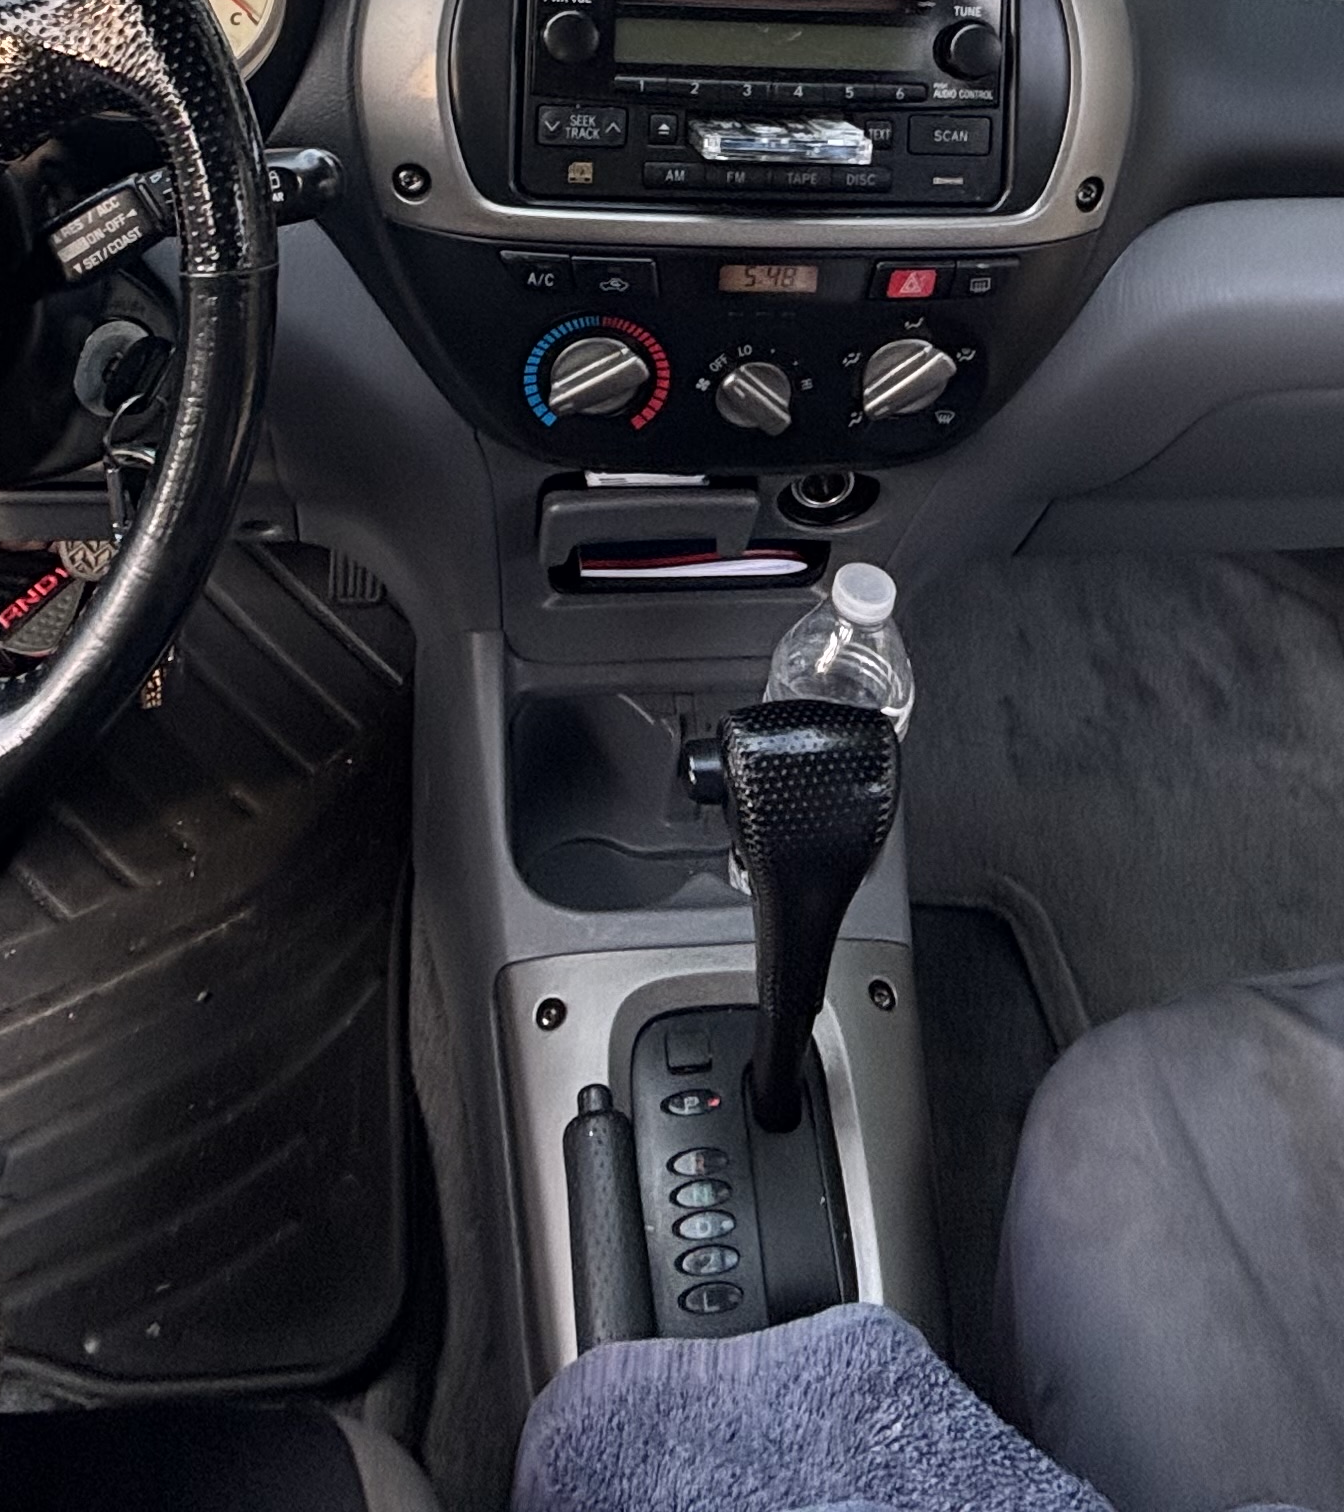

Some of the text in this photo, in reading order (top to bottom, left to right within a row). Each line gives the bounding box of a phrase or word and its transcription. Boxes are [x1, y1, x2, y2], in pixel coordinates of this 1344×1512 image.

[954, 6, 982, 17] TUNE
[229, 12, 243, 26] C
[690, 82, 699, 94] 2
[743, 84, 752, 96] 3
[793, 86, 803, 98] 4
[845, 87, 854, 99] 5
[895, 88, 904, 100] 6
[933, 89, 994, 100] AUDIO CONTROL
[570, 115, 596, 127] SEEK
[565, 127, 600, 140] TRACK
[868, 128, 891, 141] TEXT
[933, 129, 969, 142] SCAN
[665, 169, 686, 182] AM
[726, 171, 746, 184] FM
[787, 172, 818, 185] TAPE
[846, 173, 876, 186] DISC
[96, 196, 120, 217] ACC
[86, 213, 126, 245] ON-OFF
[82, 226, 143, 270] SET/COAST
[527, 270, 555, 288] A/C
[745, 266, 797, 287] 5:48
[737, 344, 752, 357] LO
[709, 353, 728, 372] OFF
[702, 1290, 720, 1312] L
